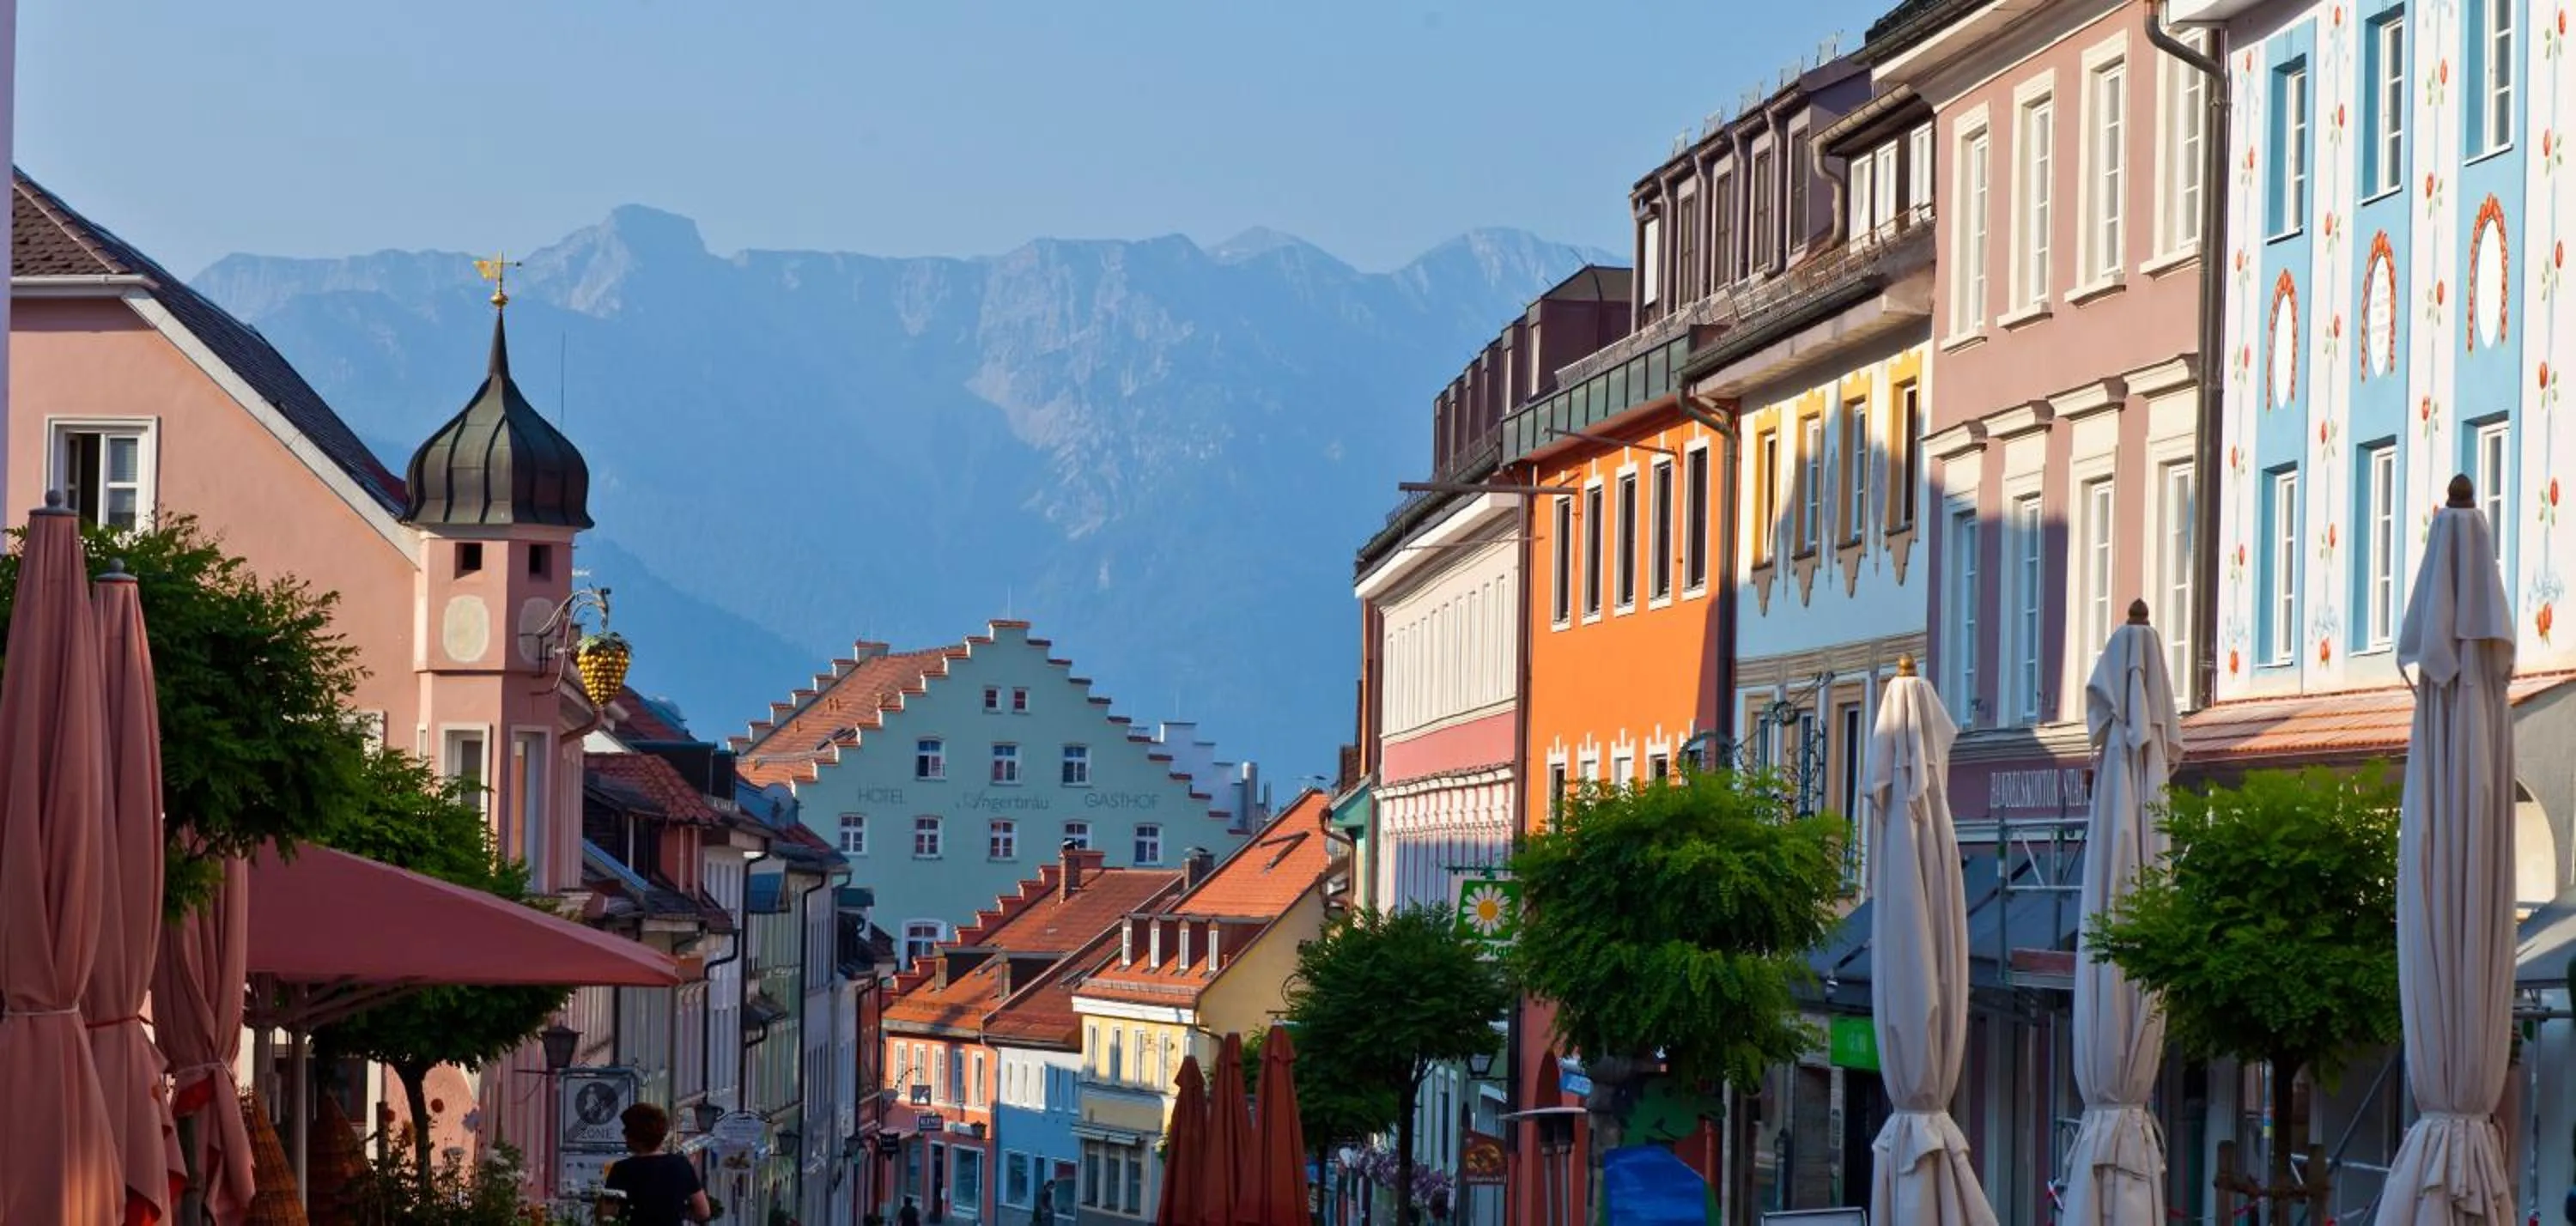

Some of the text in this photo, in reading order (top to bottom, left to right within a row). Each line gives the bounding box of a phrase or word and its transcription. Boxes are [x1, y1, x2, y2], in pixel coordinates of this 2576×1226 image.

[858, 787, 906, 804] HOTEL
[1084, 792, 1161, 809] GASTHOF
[578, 1127, 615, 1139] ZONE
